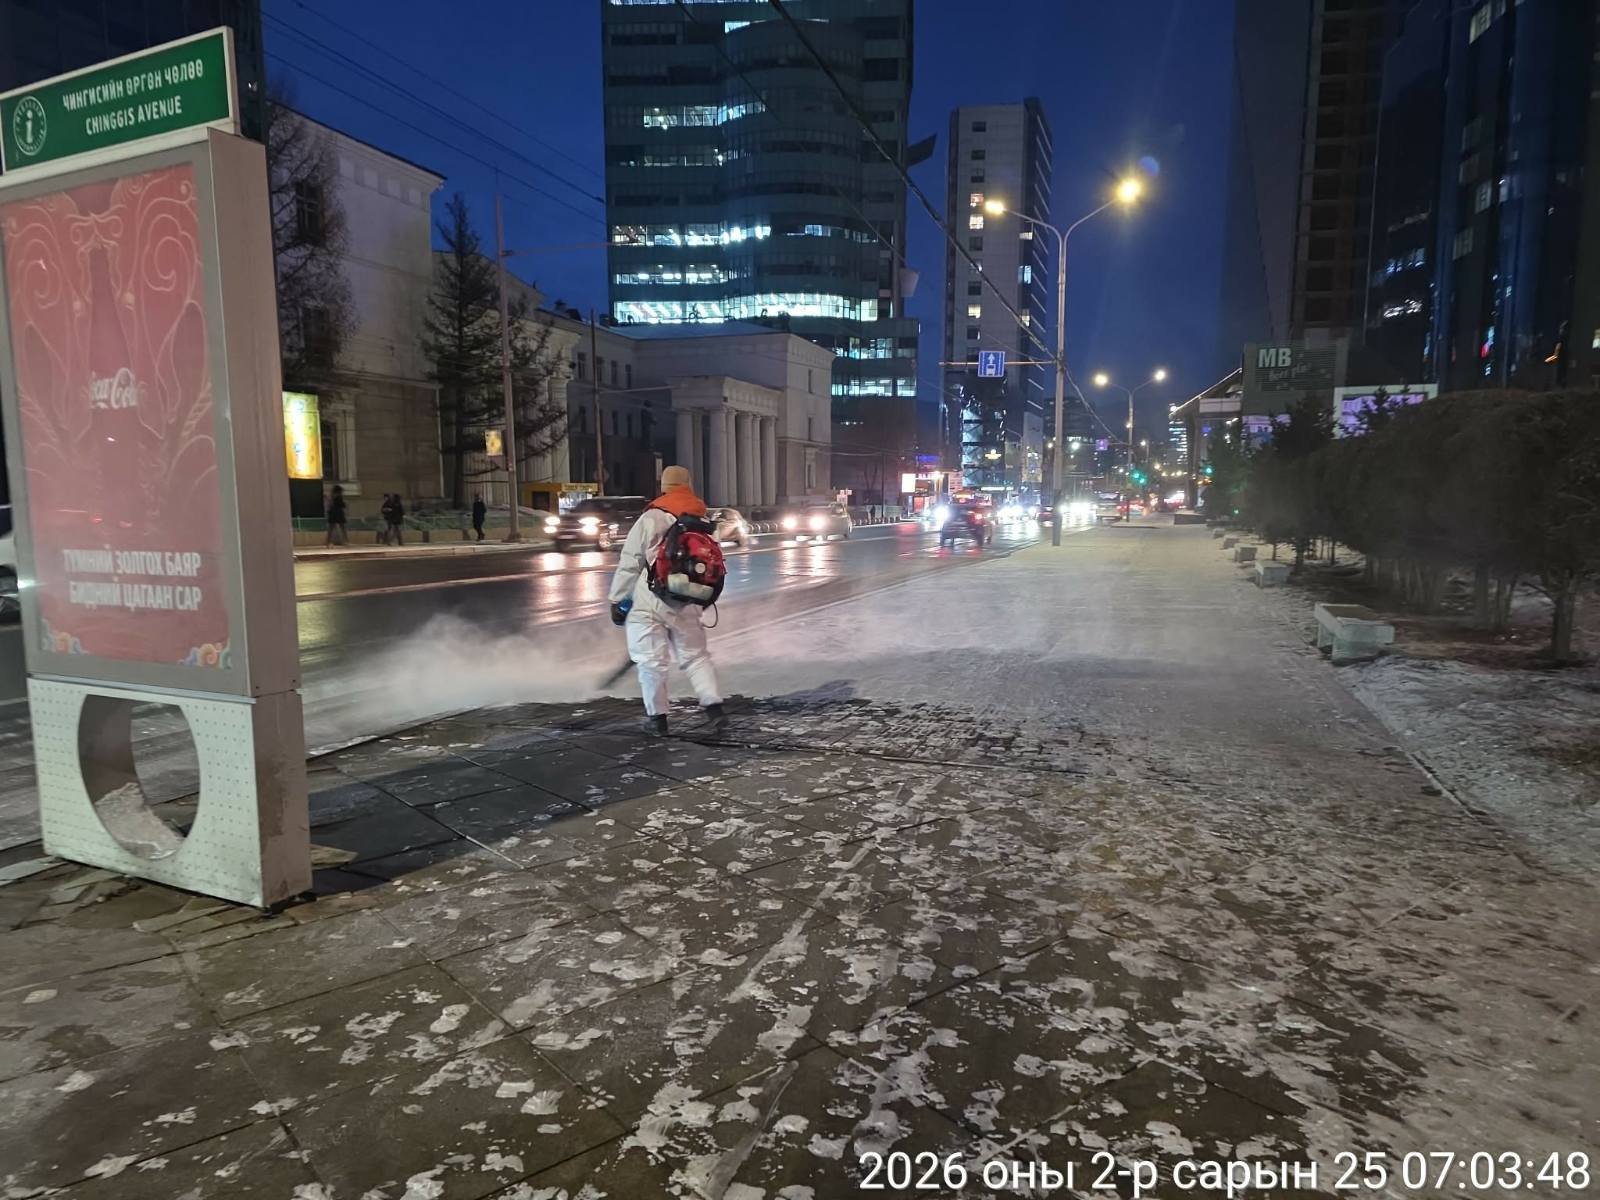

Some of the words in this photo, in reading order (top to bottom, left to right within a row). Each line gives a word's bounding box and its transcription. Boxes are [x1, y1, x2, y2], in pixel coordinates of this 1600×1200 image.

[62, 79, 124, 112] ЧИНГИСИЙН
[125, 69, 163, 95] ӨРГӨН
[164, 58, 203, 85] ЧӨЛӨӨ
[85, 107, 135, 135] CHINGGIS
[137, 95, 182, 123] AVENUE
[1257, 347, 1292, 369] MB
[115, 550, 165, 576] ЗОЛГОХ
[165, 551, 201, 577] БАЯР
[122, 583, 173, 611] ЦАГААН
[174, 585, 202, 611] САР
